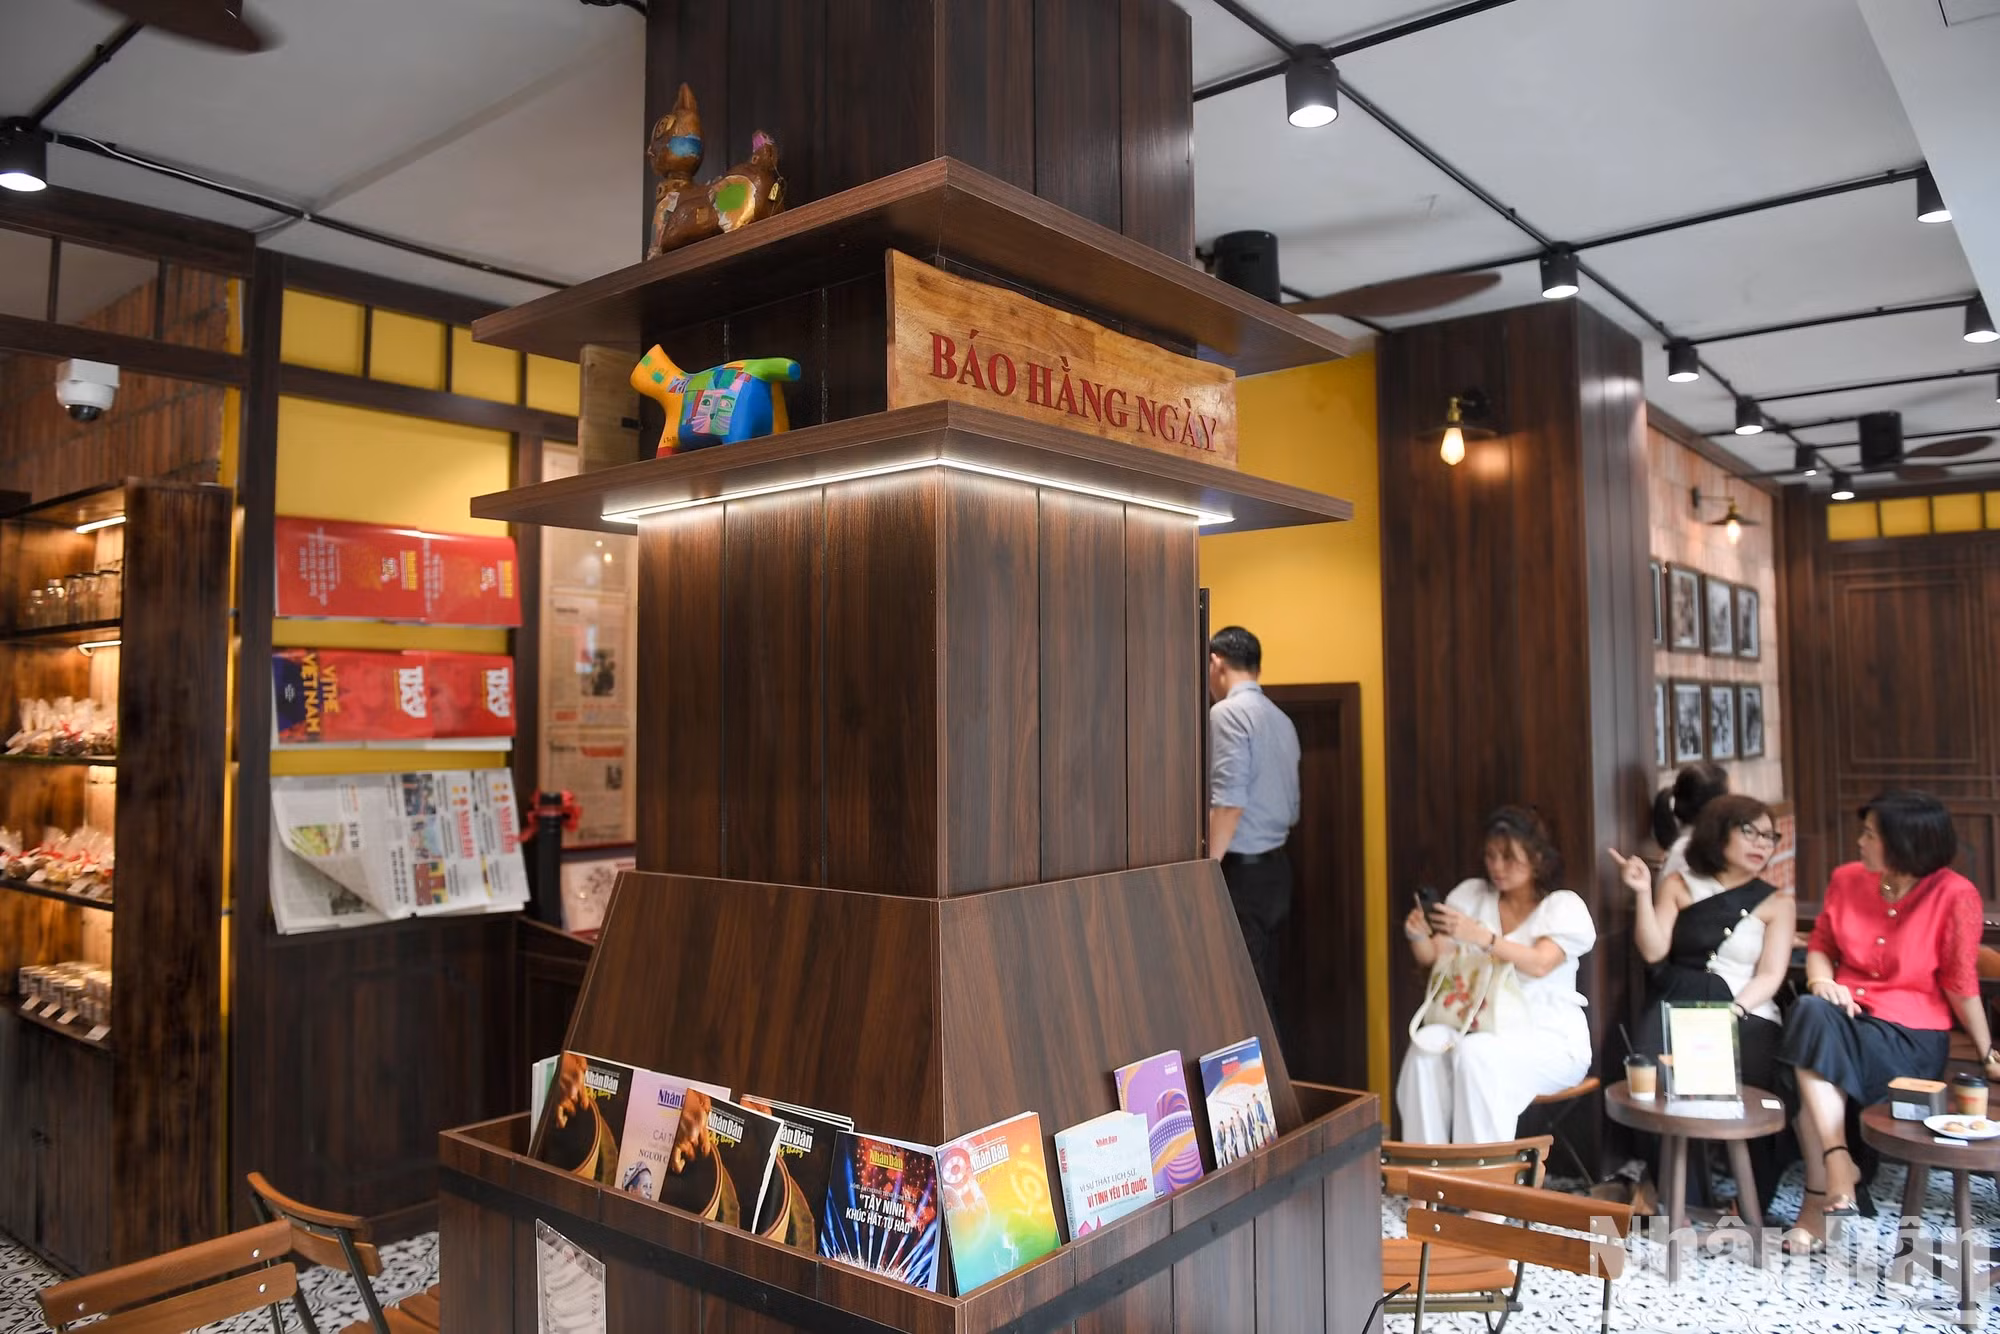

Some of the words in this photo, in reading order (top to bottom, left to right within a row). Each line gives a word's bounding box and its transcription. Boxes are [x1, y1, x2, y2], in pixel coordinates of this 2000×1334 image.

[929, 329, 1017, 397] BÁO
[1026, 355, 1129, 428] HẰNG
[1135, 395, 1217, 452] NGÀY
[659, 1089, 680, 1107] Nhân
[727, 1118, 744, 1140] Dân
[780, 1125, 794, 1143] ân
[794, 1128, 813, 1149] Dân
[870, 1150, 889, 1167] Nhân
[889, 1155, 904, 1169] Dân
[1111, 1171, 1126, 1182] LỊCH
[1094, 1189, 1109, 1206] TÌNH
[1109, 1184, 1121, 1202] YÊU
[1121, 1179, 1130, 1196] TỔ
[1130, 1176, 1148, 1195] QUỐC
[846, 1206, 866, 1222] KHÚC
[867, 1211, 883, 1227] HÁT
[883, 1200, 906, 1218] NINH
